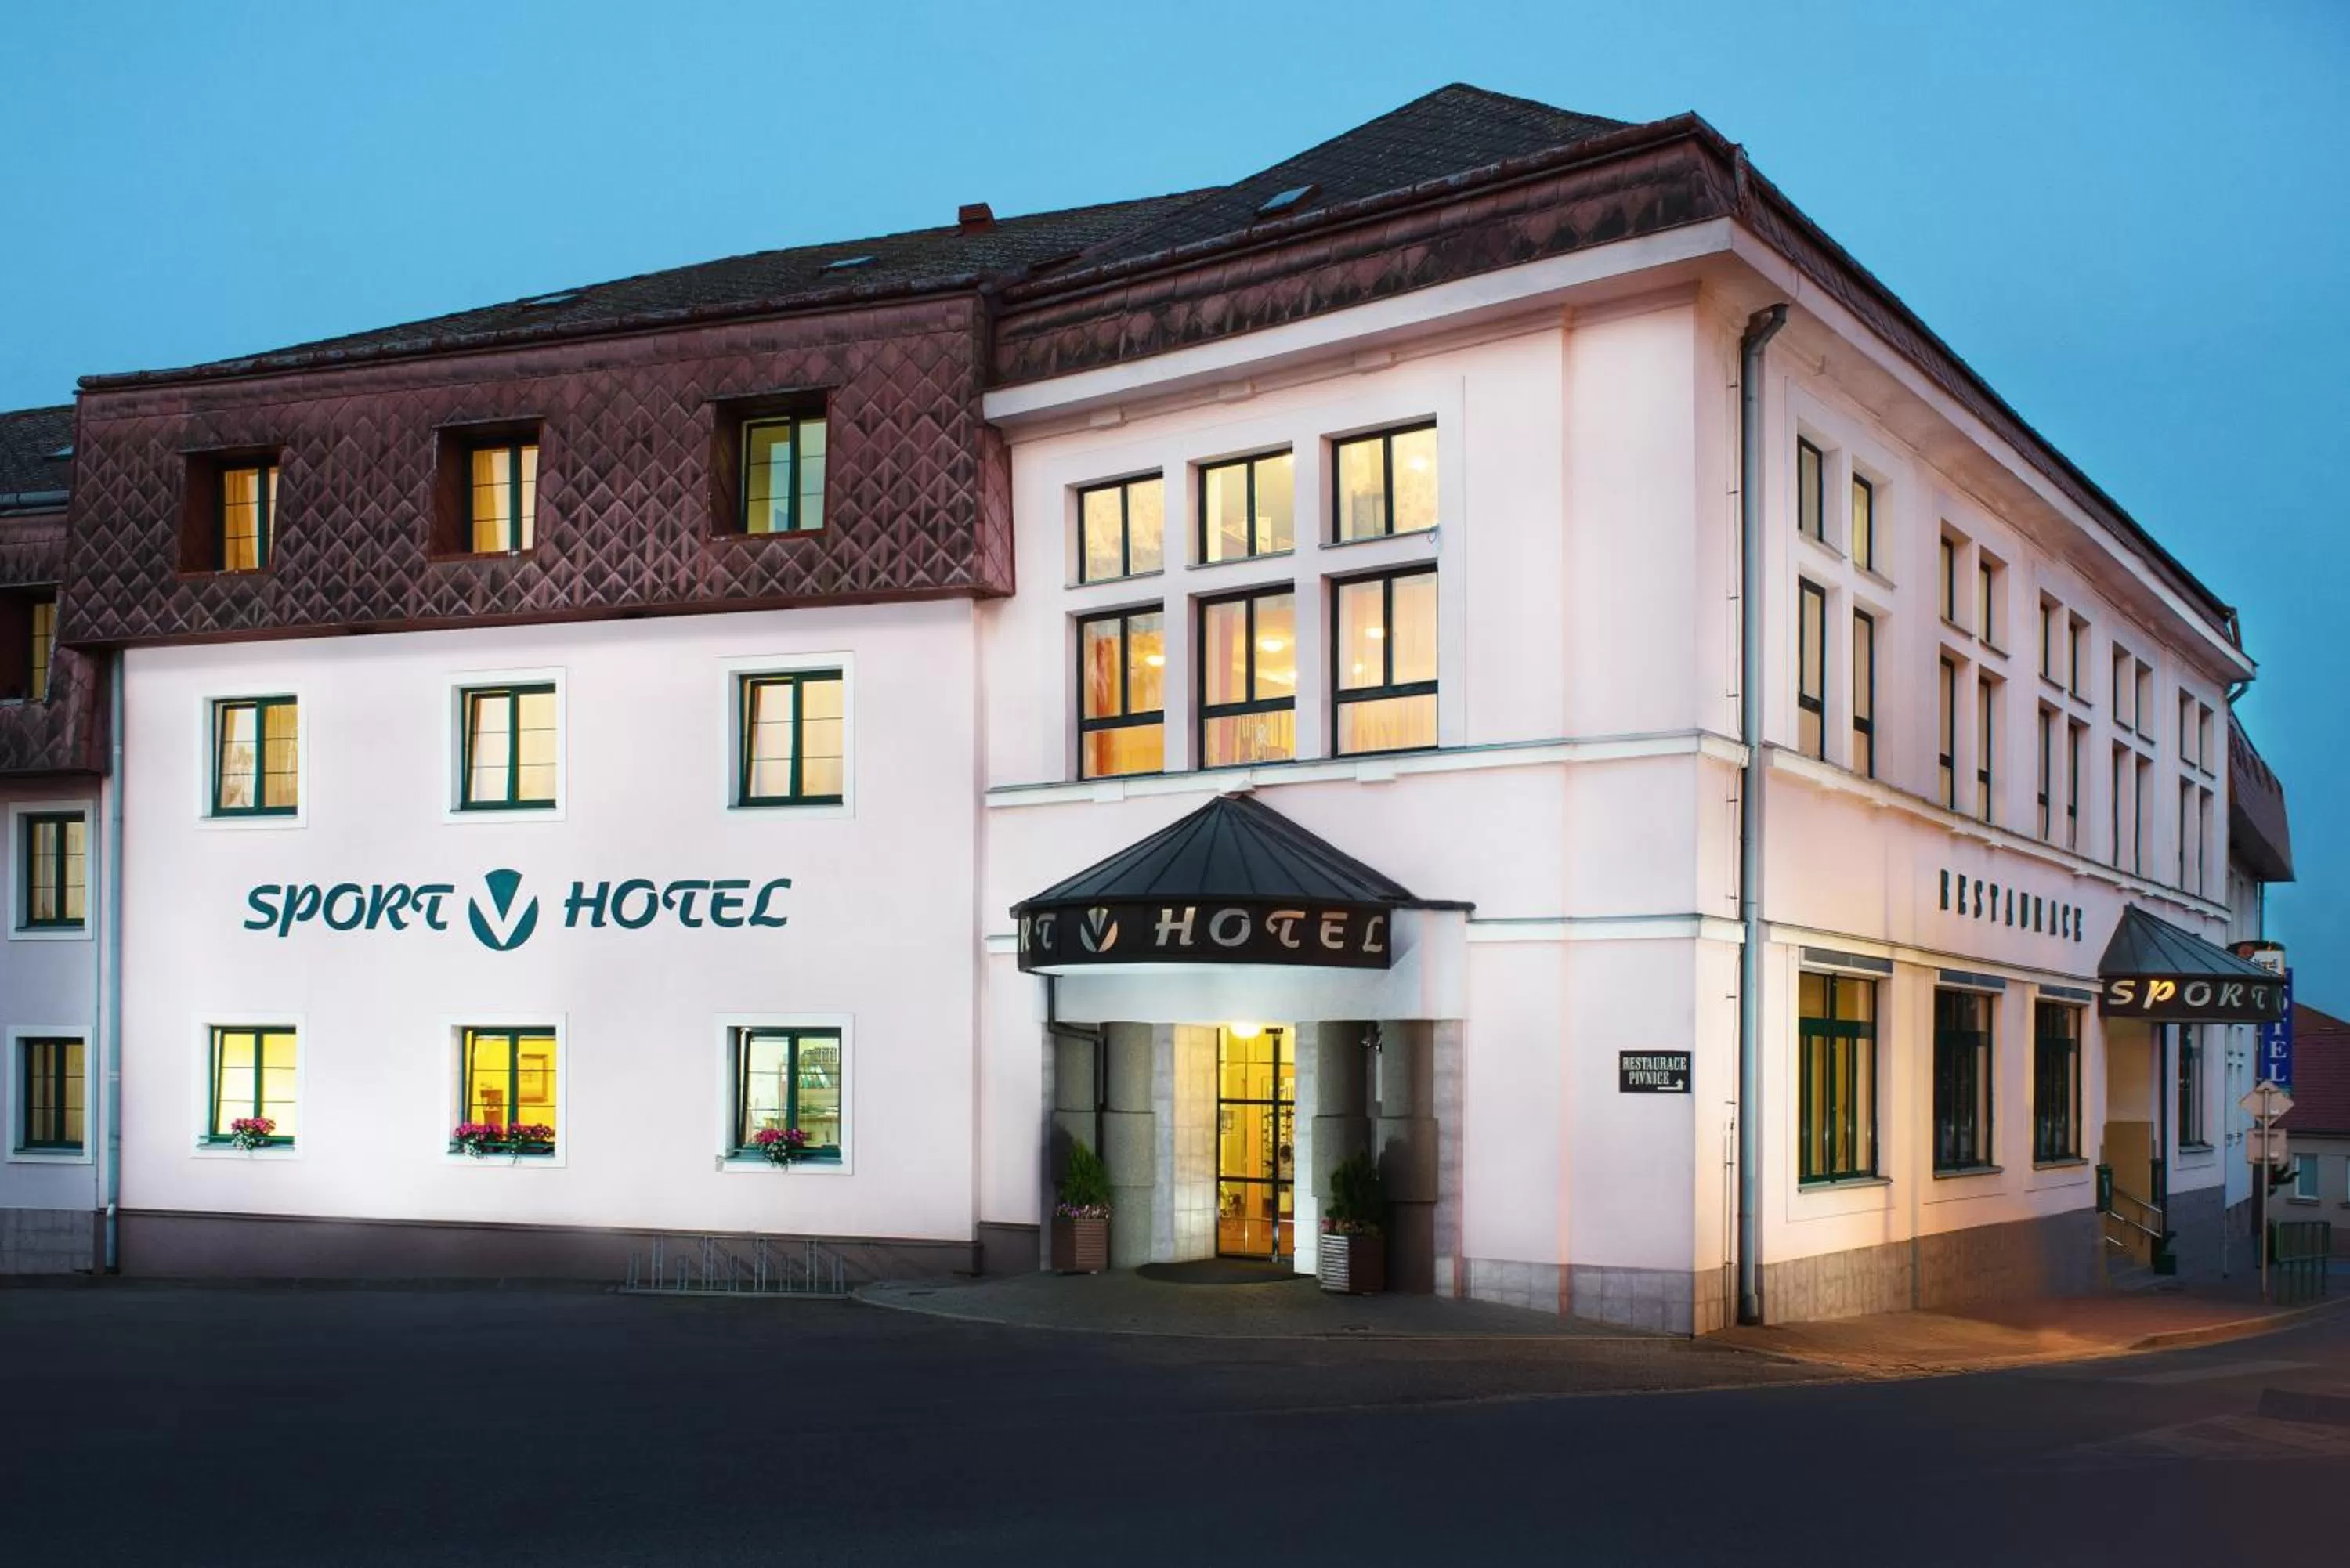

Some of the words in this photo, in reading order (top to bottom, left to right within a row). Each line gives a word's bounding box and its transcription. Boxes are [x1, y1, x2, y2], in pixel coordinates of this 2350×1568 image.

[244, 883, 455, 937] SPORT
[564, 878, 792, 928] HOTEL
[1940, 869, 2082, 942] RESTAURACE
[1154, 906, 1384, 953] HOTEL
[2107, 980, 2269, 1010] SPORT
[1622, 1057, 1687, 1071] RESTAURACE
[1629, 1071, 1670, 1085] PIVNICE
